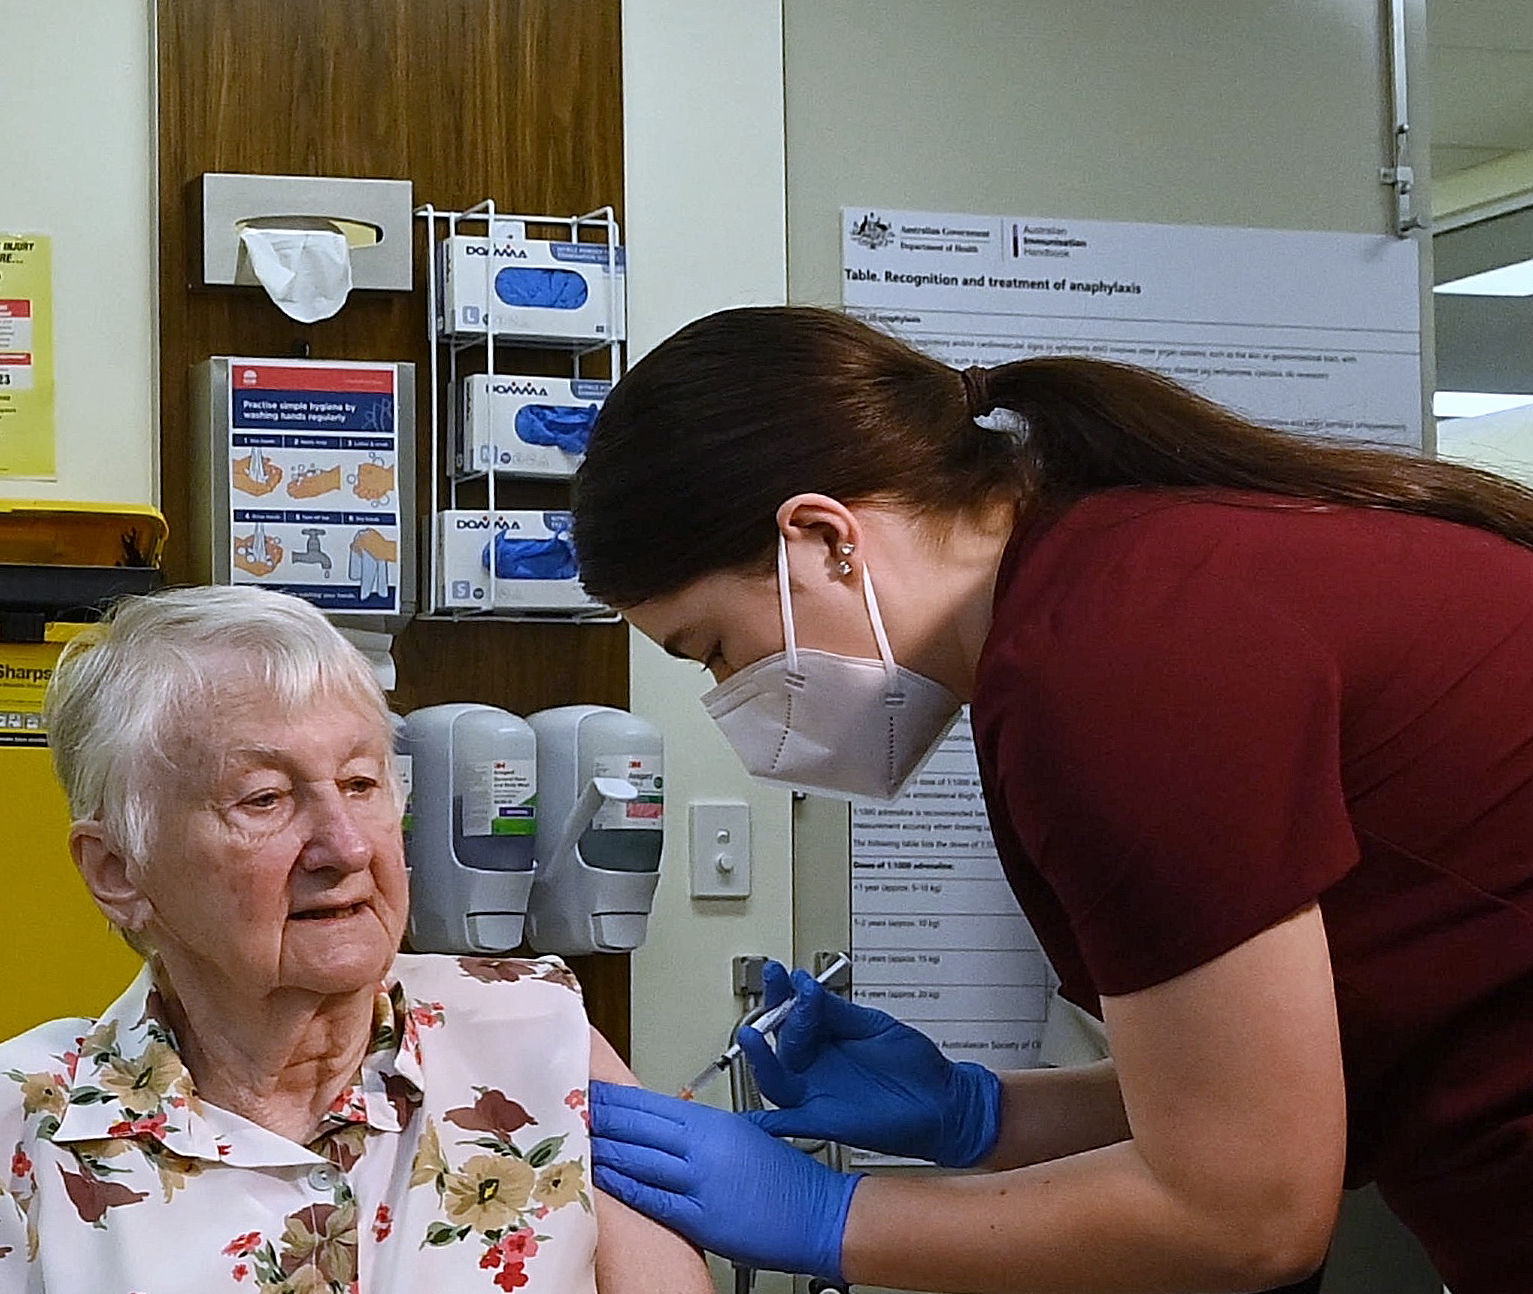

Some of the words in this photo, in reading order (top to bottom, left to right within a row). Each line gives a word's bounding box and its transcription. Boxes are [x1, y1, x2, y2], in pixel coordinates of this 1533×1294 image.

[901, 226, 940, 235] Australian
[942, 228, 990, 237] Government
[1023, 225, 1067, 235] Australian
[3, 242, 34, 251] INJURY
[900, 241, 944, 252] Department
[945, 243, 953, 251] of
[954, 244, 979, 253] Health
[1023, 237, 1087, 247] Immunisation
[1023, 247, 1070, 257] Handbook
[845, 268, 881, 282] Table.
[884, 270, 958, 288] Recognition
[961, 276, 985, 287] and
[988, 277, 1050, 291] treatment
[1053, 278, 1067, 291] of
[1069, 281, 1142, 296] anaphylaxis
[466, 309, 475, 322] L
[243, 400, 277, 410] Practise
[279, 401, 308, 412] simple
[309, 401, 343, 413] hygiene
[345, 403, 356, 413] by
[243, 412, 278, 422] washing
[280, 411, 306, 421] hands
[308, 412, 346, 423] regularly
[457, 583, 466, 596] S
[854, 839, 866, 847] The
[868, 840, 900, 849] following
[864, 885, 879, 893] year
[868, 920, 886, 929] years
[919, 919, 927, 927] 10
[868, 956, 886, 964] years
[918, 955, 927, 963] 15
[868, 991, 886, 999] years
[942, 1040, 989, 1049] Australasian
[991, 1040, 1019, 1051] Society
[1021, 1041, 1030, 1050] of
